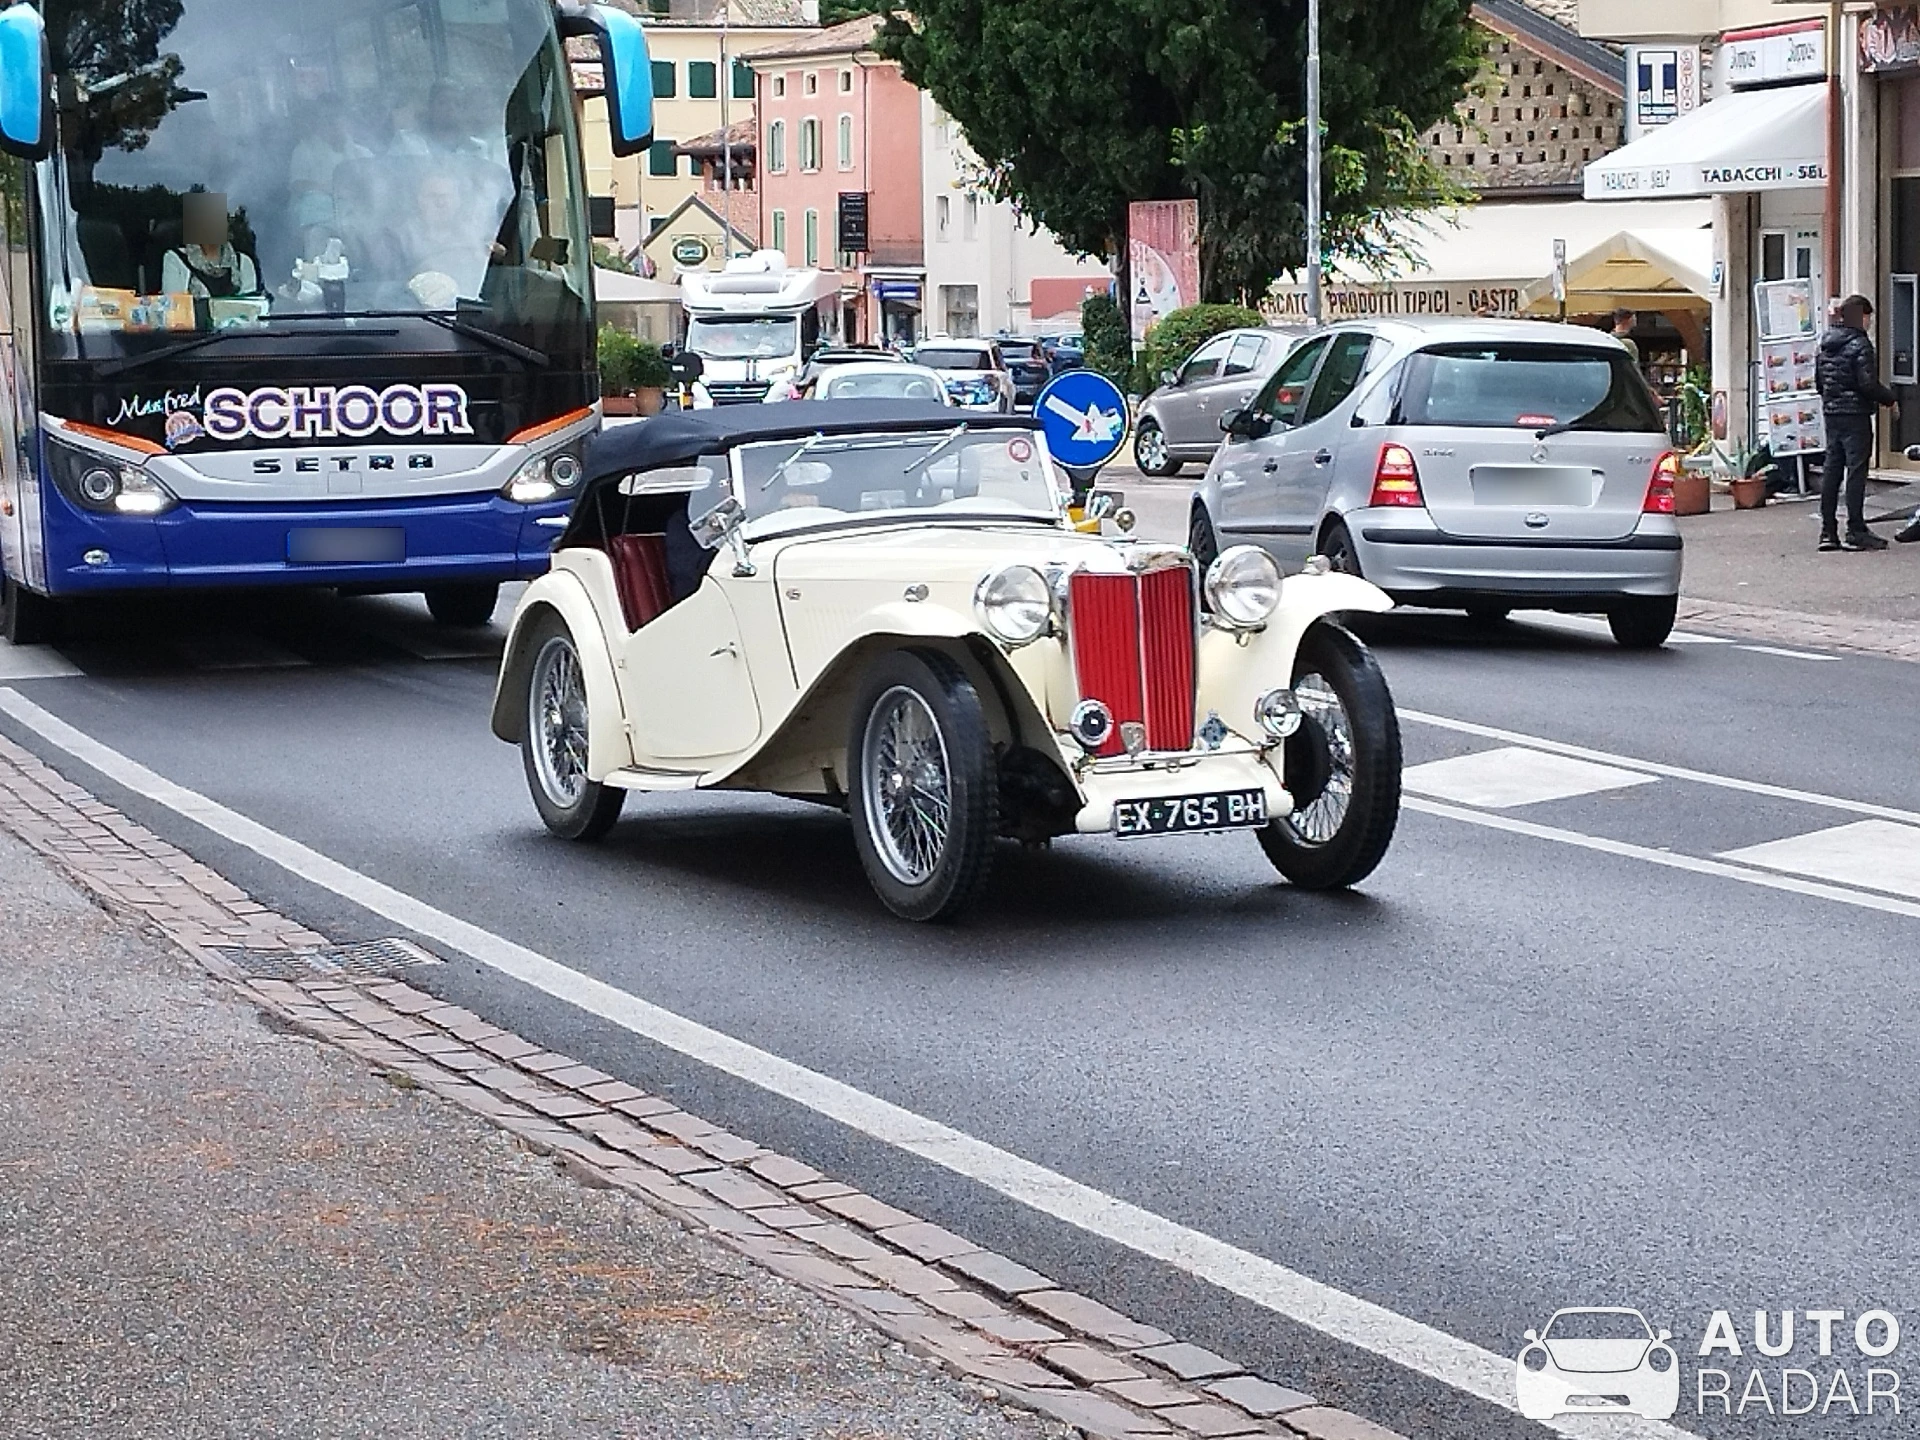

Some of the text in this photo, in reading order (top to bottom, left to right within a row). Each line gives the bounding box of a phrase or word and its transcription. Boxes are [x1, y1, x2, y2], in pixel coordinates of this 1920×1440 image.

[1701, 167, 1781, 183] TABACCHI
[1797, 165, 1828, 180] SEL
[1258, 292, 1309, 315] ERCATO
[1329, 290, 1398, 314] PRODOTTI
[1404, 290, 1449, 314] TIPICI
[1469, 288, 1519, 312] GASTR
[106, 384, 201, 426] Manfred
[204, 383, 474, 440] SCHOOR
[252, 454, 434, 474] SETRA
[1117, 793, 1267, 833] EX 765 BH
